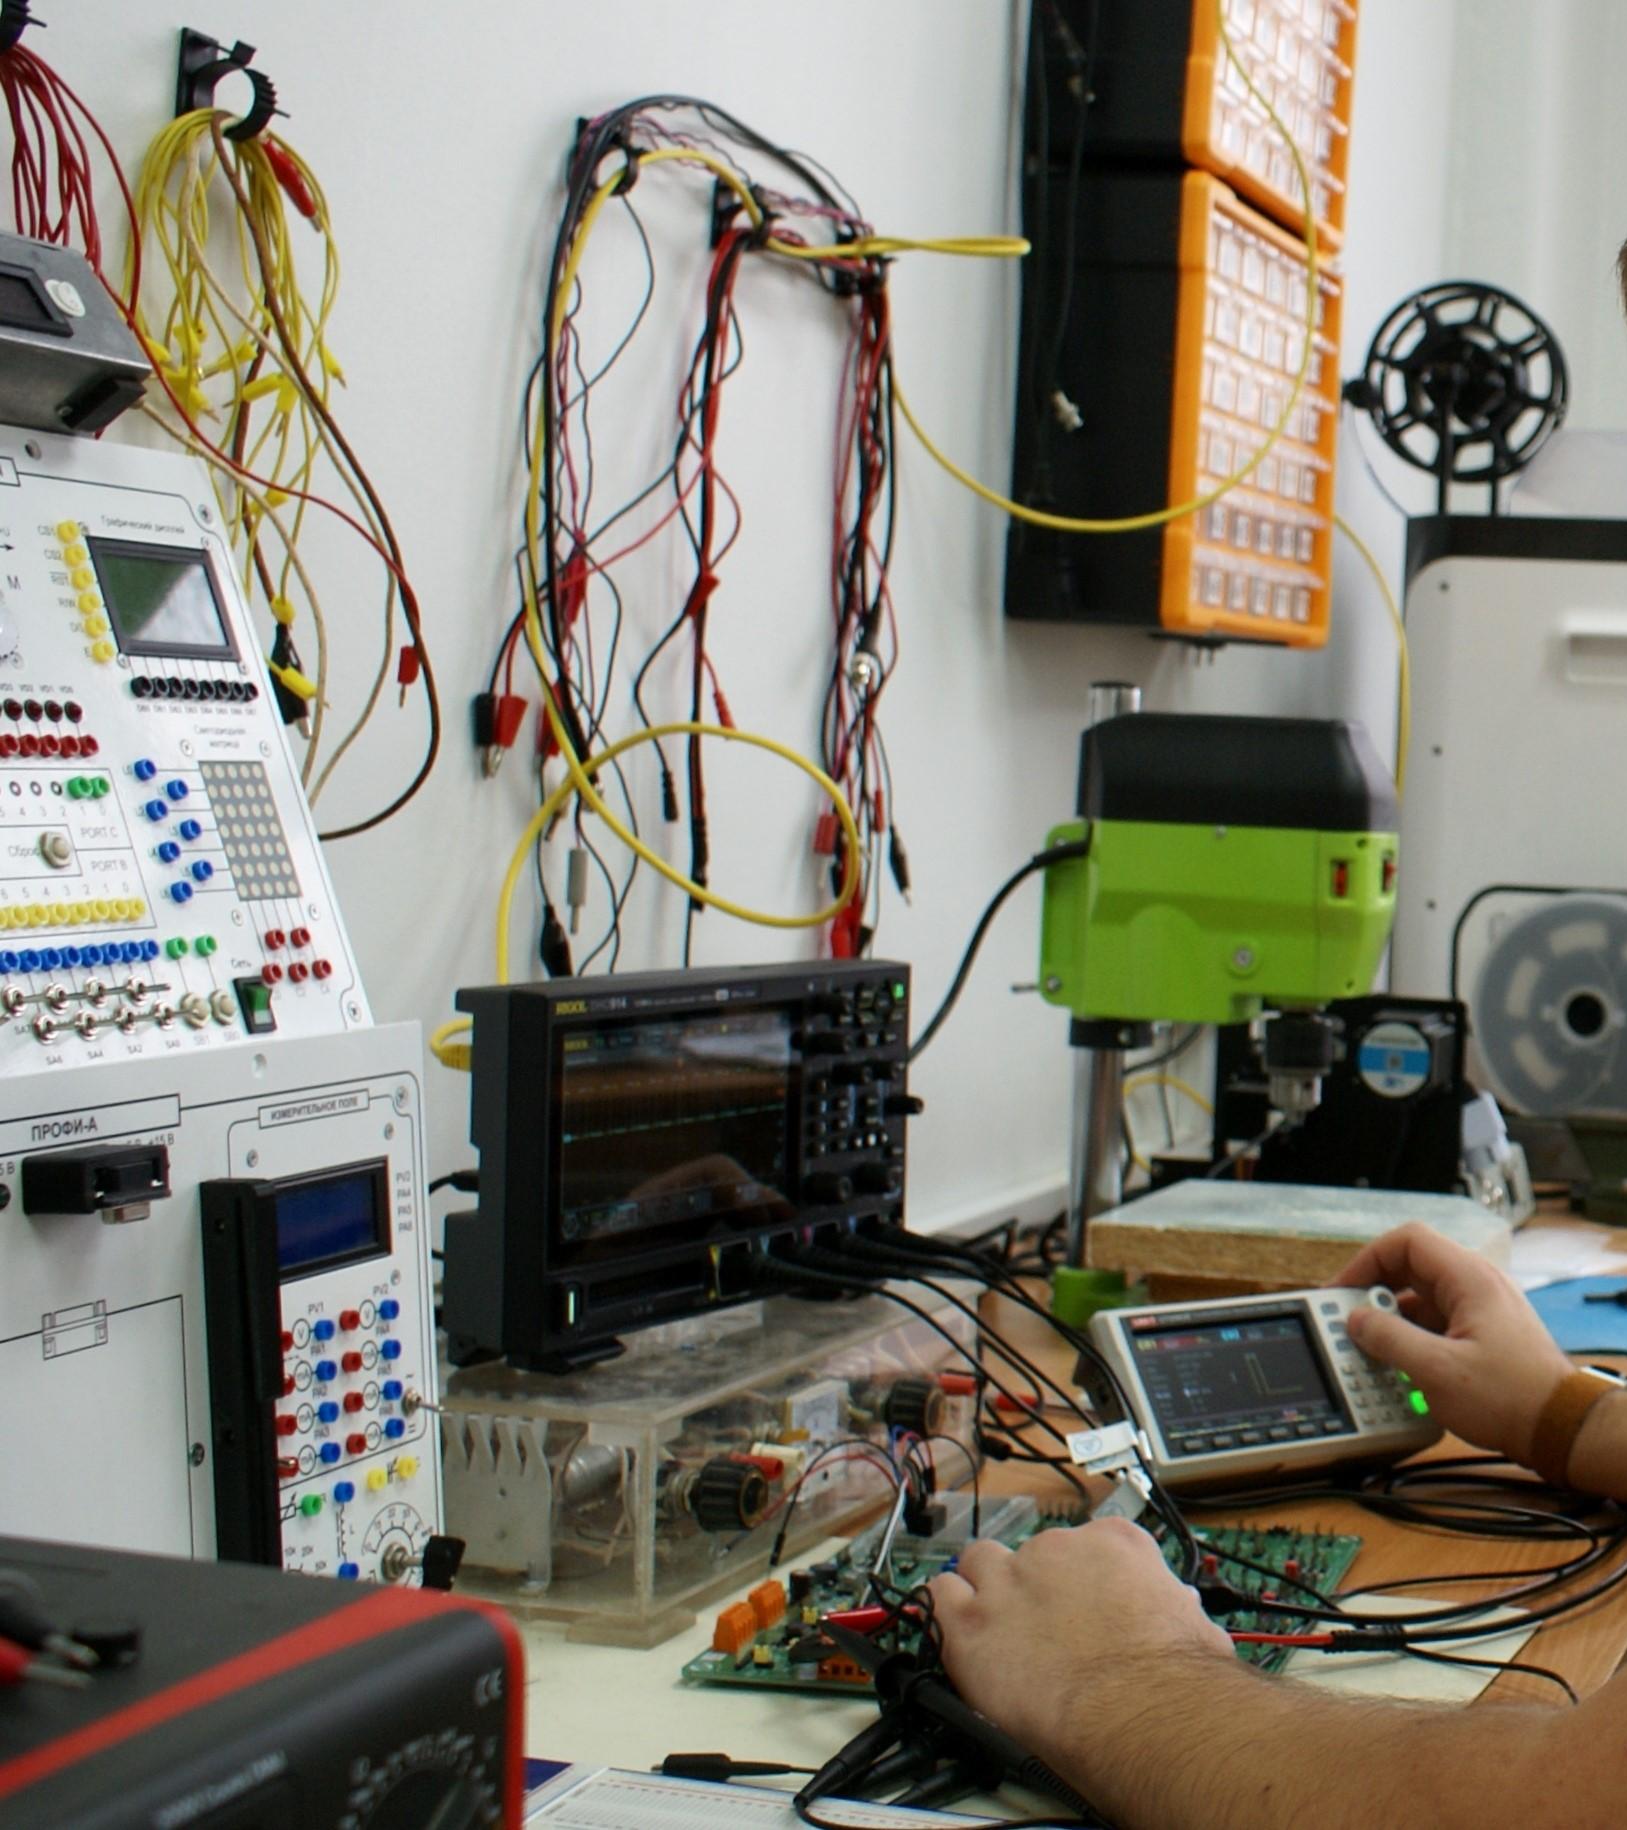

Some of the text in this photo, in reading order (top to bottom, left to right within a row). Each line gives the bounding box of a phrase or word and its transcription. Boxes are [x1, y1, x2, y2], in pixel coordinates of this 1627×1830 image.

[80, 827, 119, 839] PORT C
[91, 861, 117, 871] PORT
[127, 1045, 143, 1055] SA2
[271, 1099, 337, 1120] ИЗМЕРИТЕЛЬНОЕ
[31, 1116, 98, 1141] ПРОФИ-А
[308, 1301, 325, 1315] PV1
